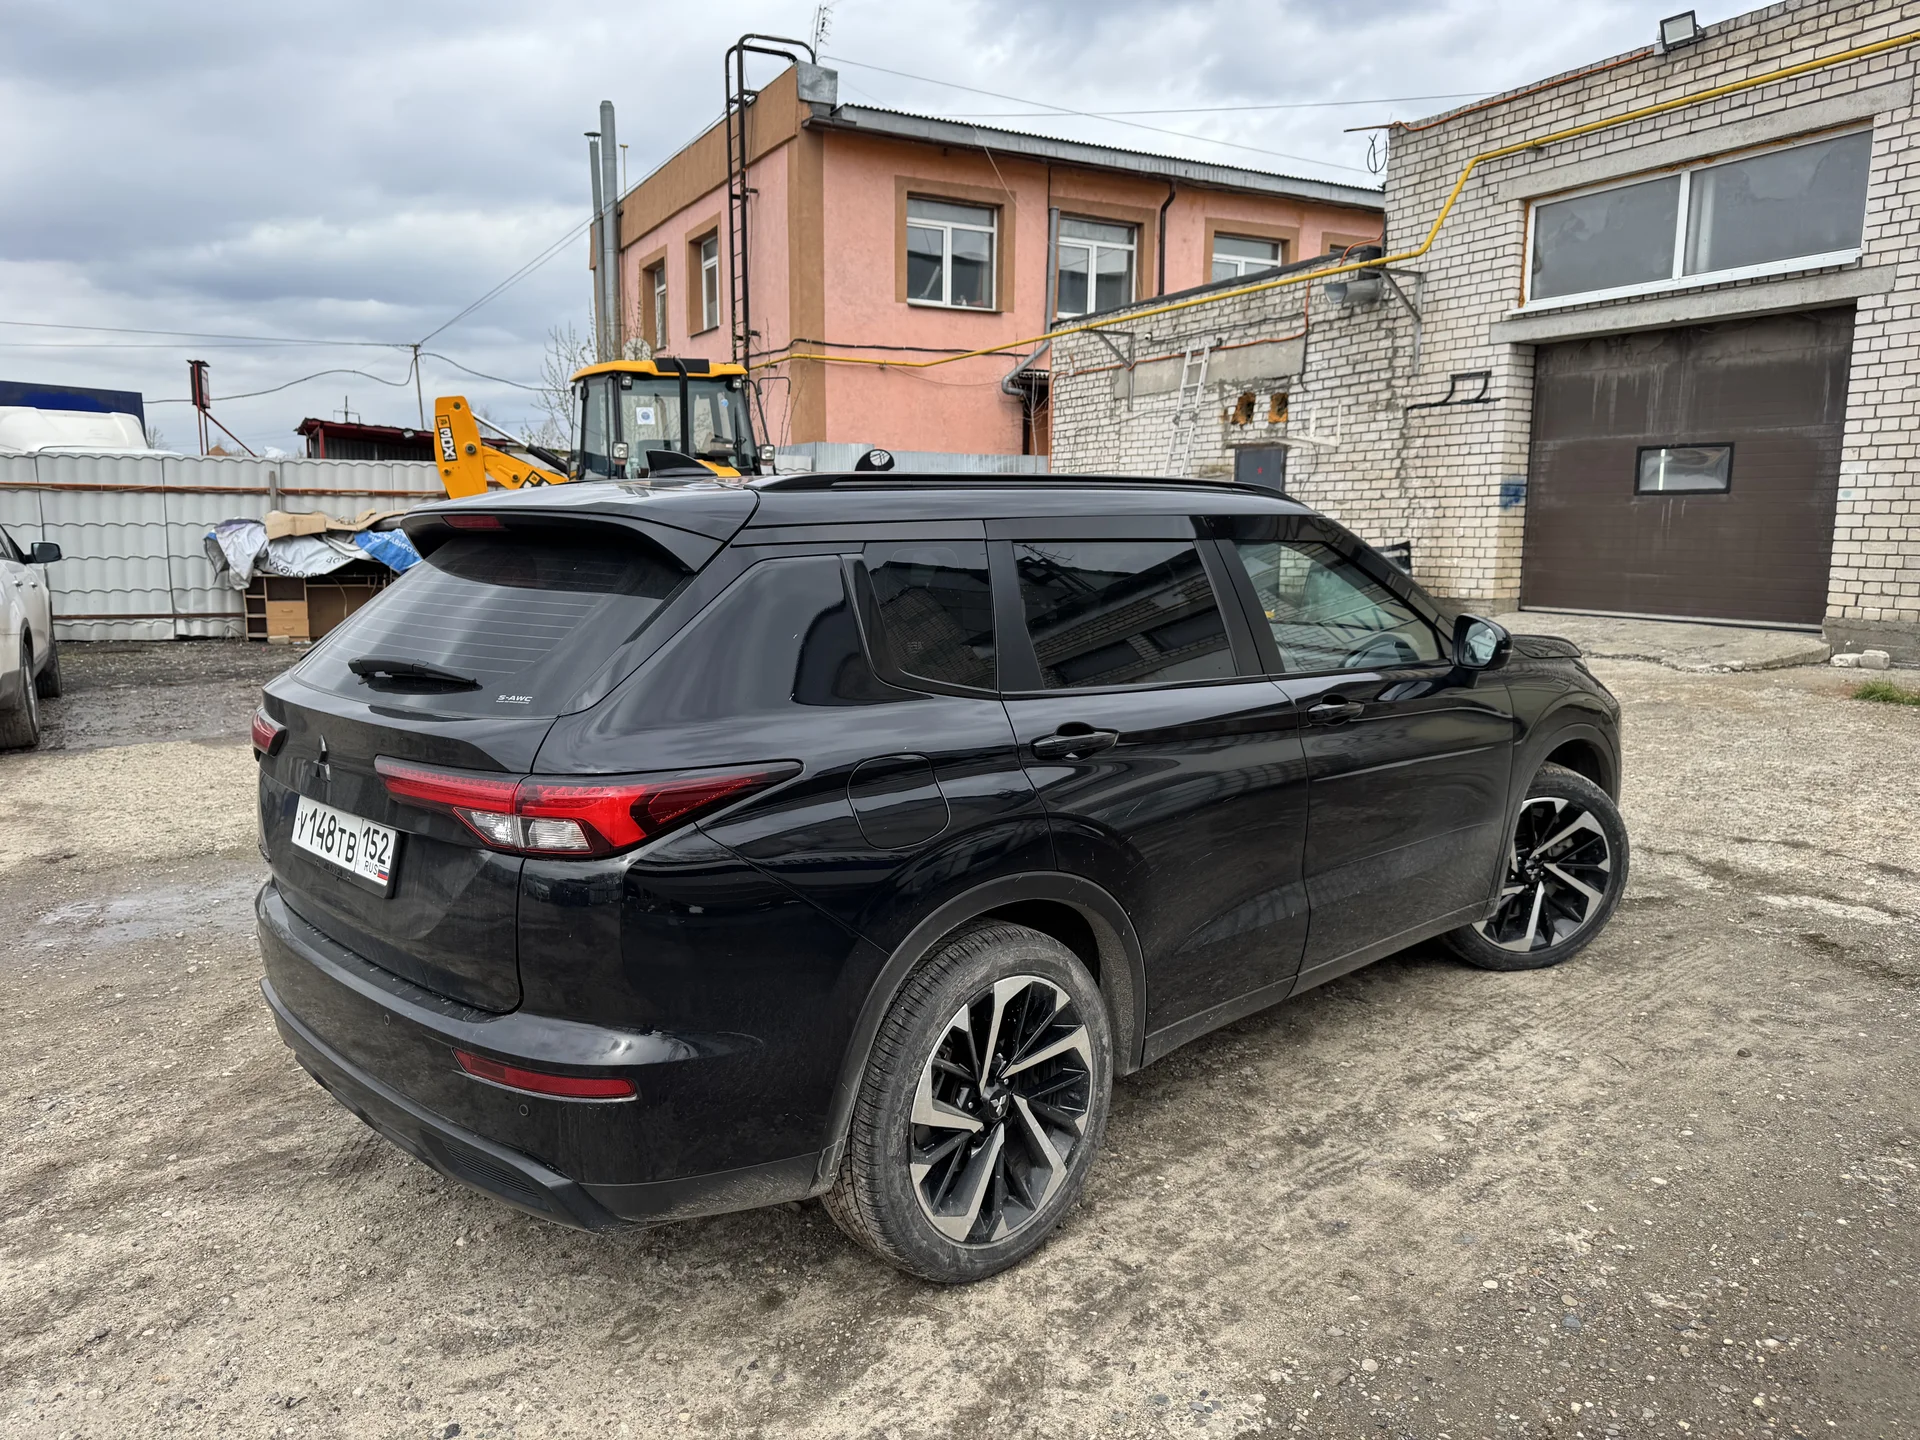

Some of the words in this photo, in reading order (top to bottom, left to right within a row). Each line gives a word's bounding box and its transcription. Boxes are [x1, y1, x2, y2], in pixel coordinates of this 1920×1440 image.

[440, 428, 456, 457] 3DX
[498, 694, 533, 702] S-AWC
[363, 826, 389, 865] 152
[364, 860, 378, 876] RUS
